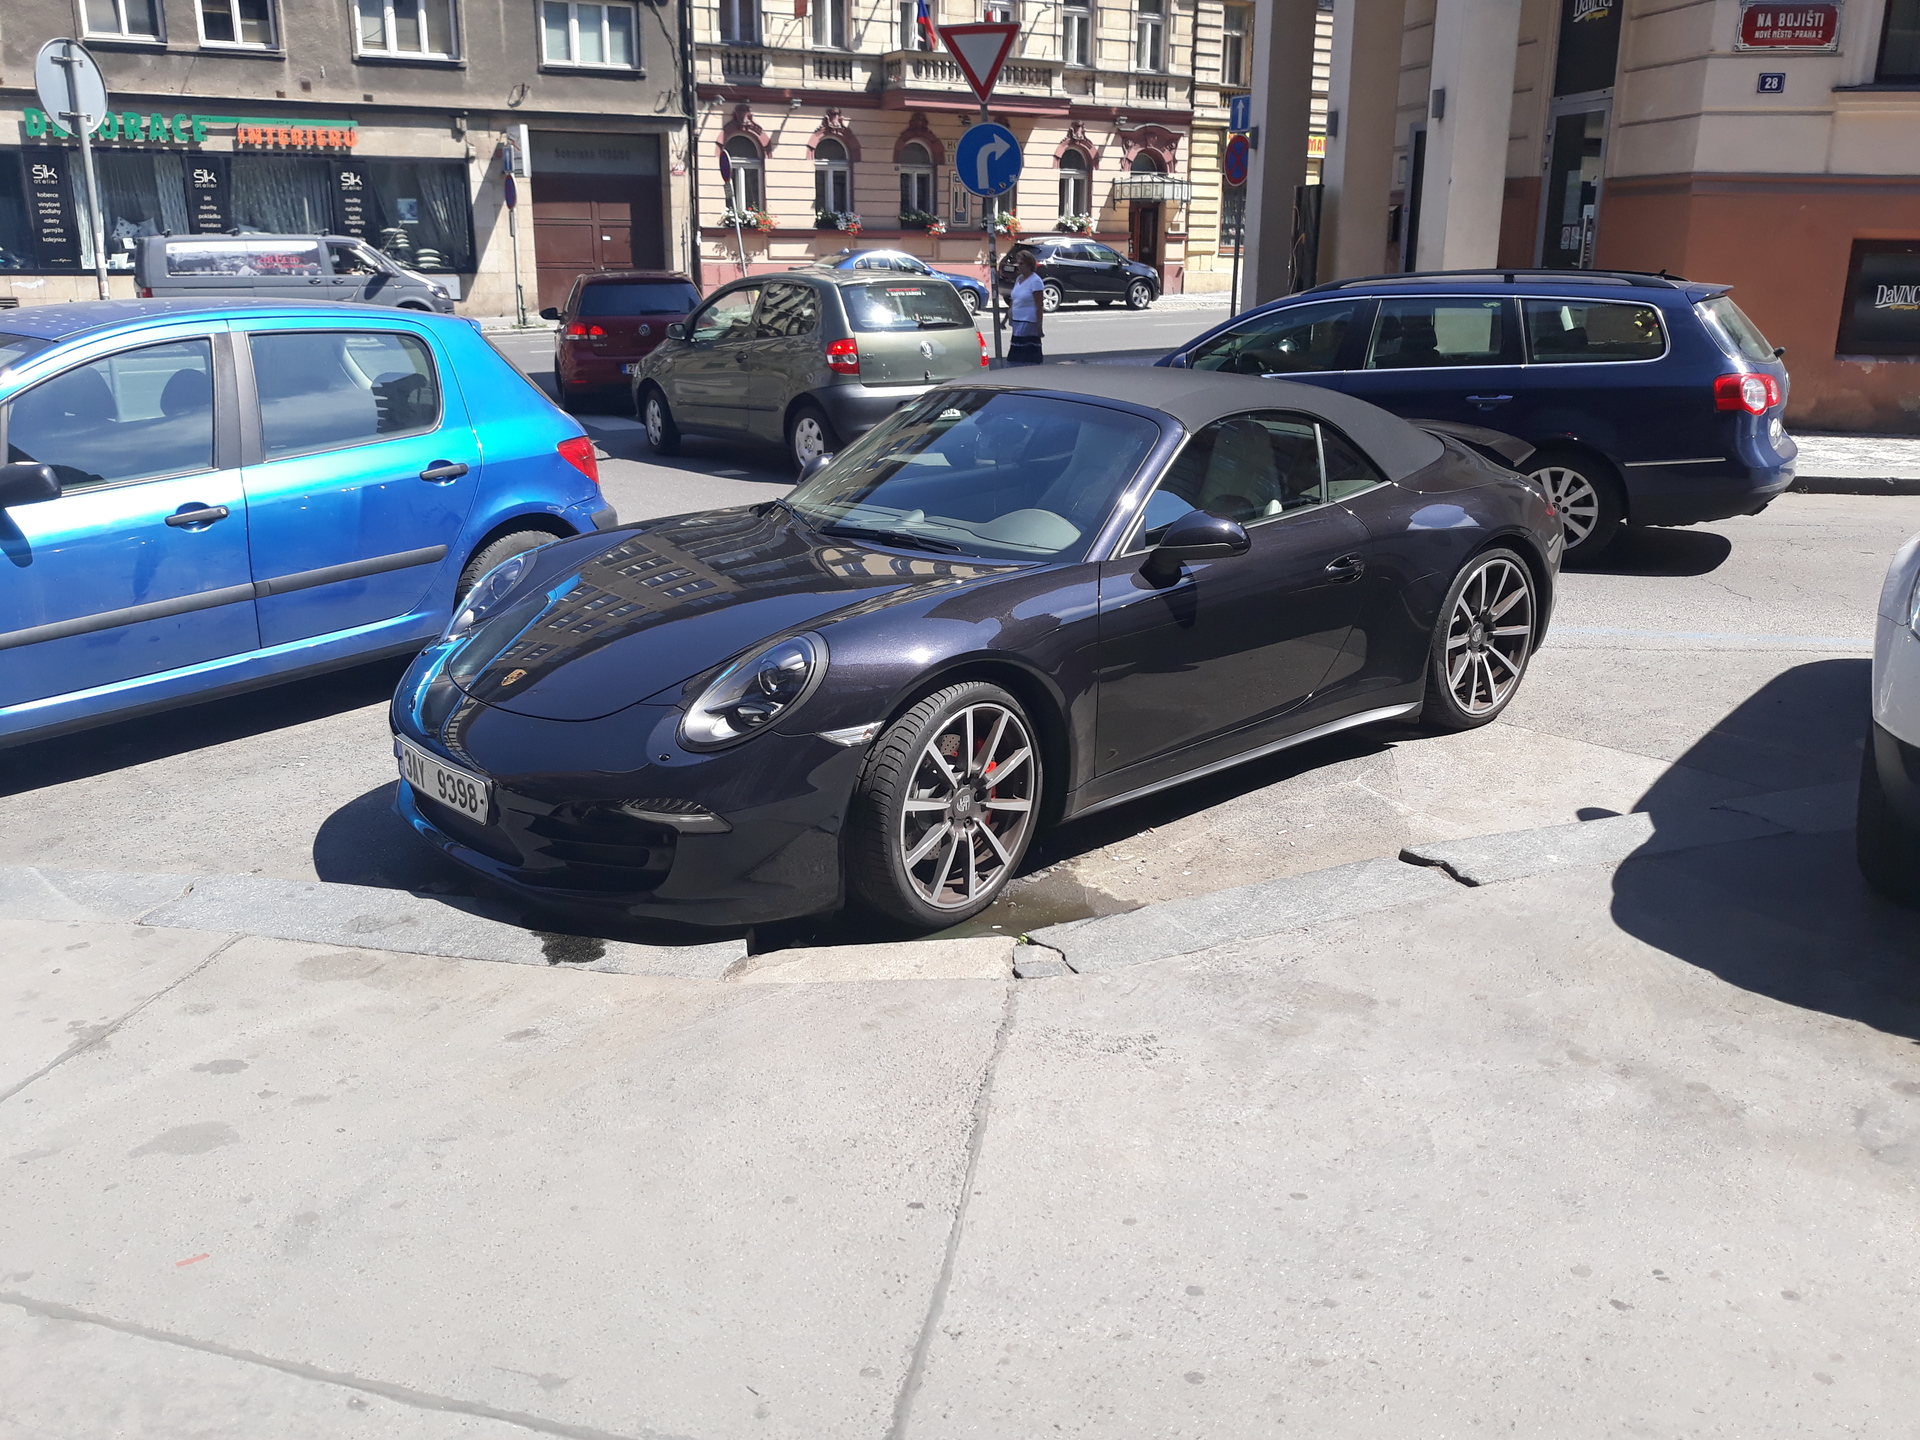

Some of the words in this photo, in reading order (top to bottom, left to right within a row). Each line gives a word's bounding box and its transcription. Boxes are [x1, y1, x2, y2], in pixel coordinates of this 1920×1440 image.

[1757, 13, 1772, 27] NA
[1778, 10, 1825, 27] BOJIŠTI
[1754, 29, 1771, 39] NOVÉ
[1817, 30, 1823, 38] 2
[1764, 77, 1779, 89] 28
[23, 108, 208, 142] DORACE
[1115, 185, 1163, 198] HOTEL
[1874, 285, 1920, 306] DaVINC
[404, 749, 425, 789] 3AY
[437, 769, 478, 814] 9398
